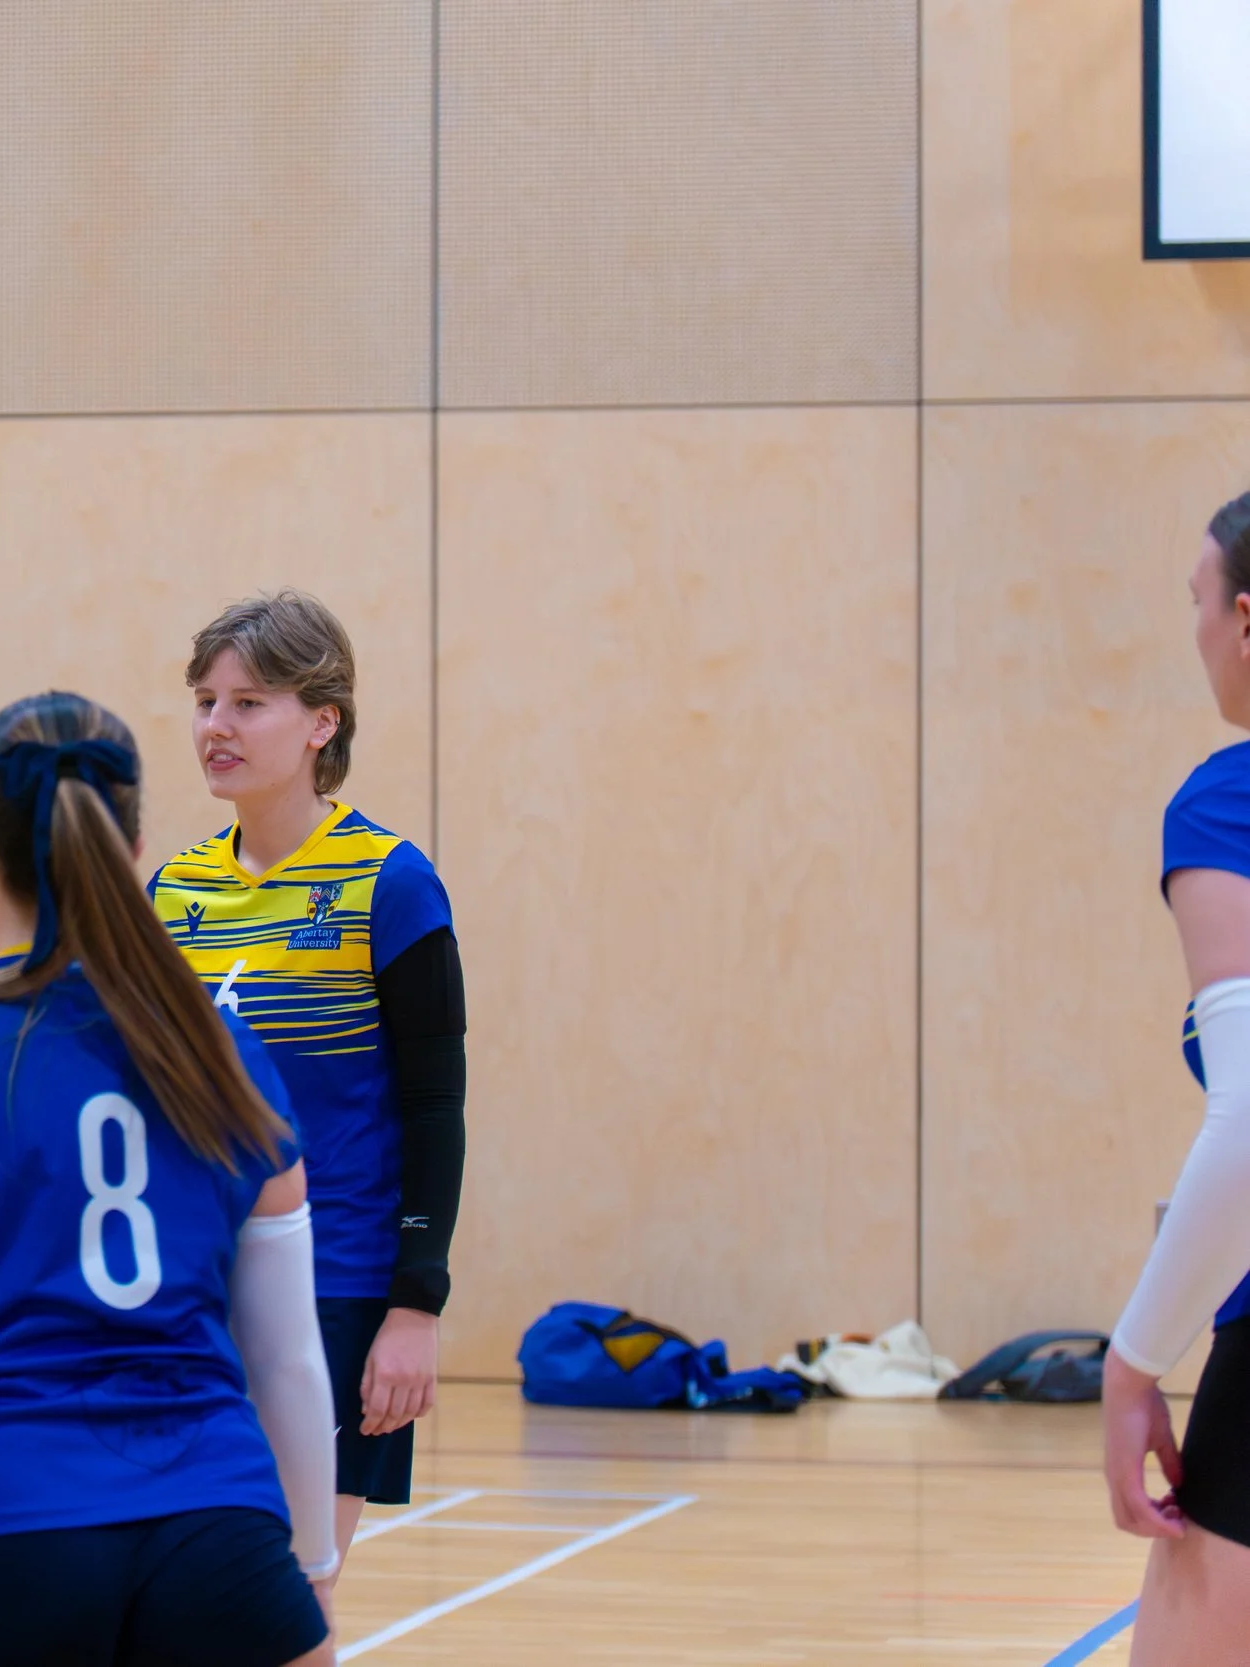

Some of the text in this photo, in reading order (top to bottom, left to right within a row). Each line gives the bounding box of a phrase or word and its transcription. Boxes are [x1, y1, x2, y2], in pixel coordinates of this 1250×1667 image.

[295, 929, 336, 939] Abertay
[288, 938, 340, 949] University
[78, 1091, 162, 1310] 8
